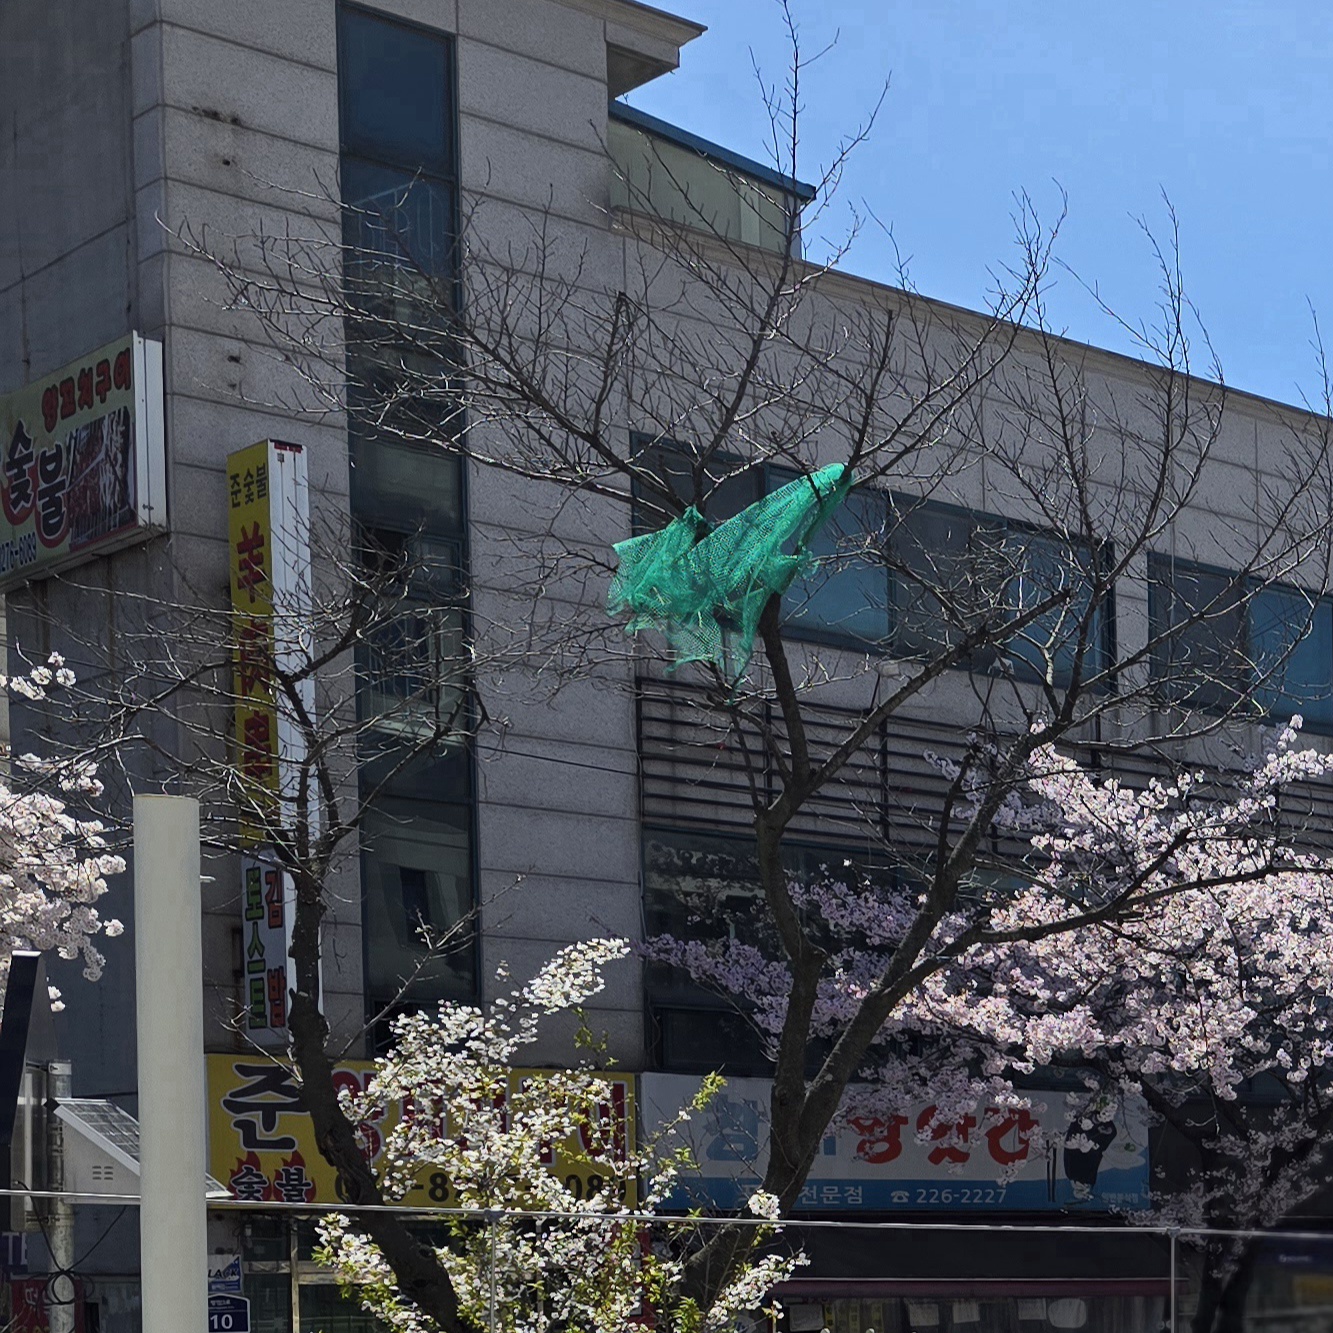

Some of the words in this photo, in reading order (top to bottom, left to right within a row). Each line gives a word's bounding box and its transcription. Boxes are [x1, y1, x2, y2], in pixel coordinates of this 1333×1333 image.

[229, 462, 268, 509] 준숯불
[229, 1164, 312, 1203] 숯불
[916, 1188, 1007, 1205] 226-2227
